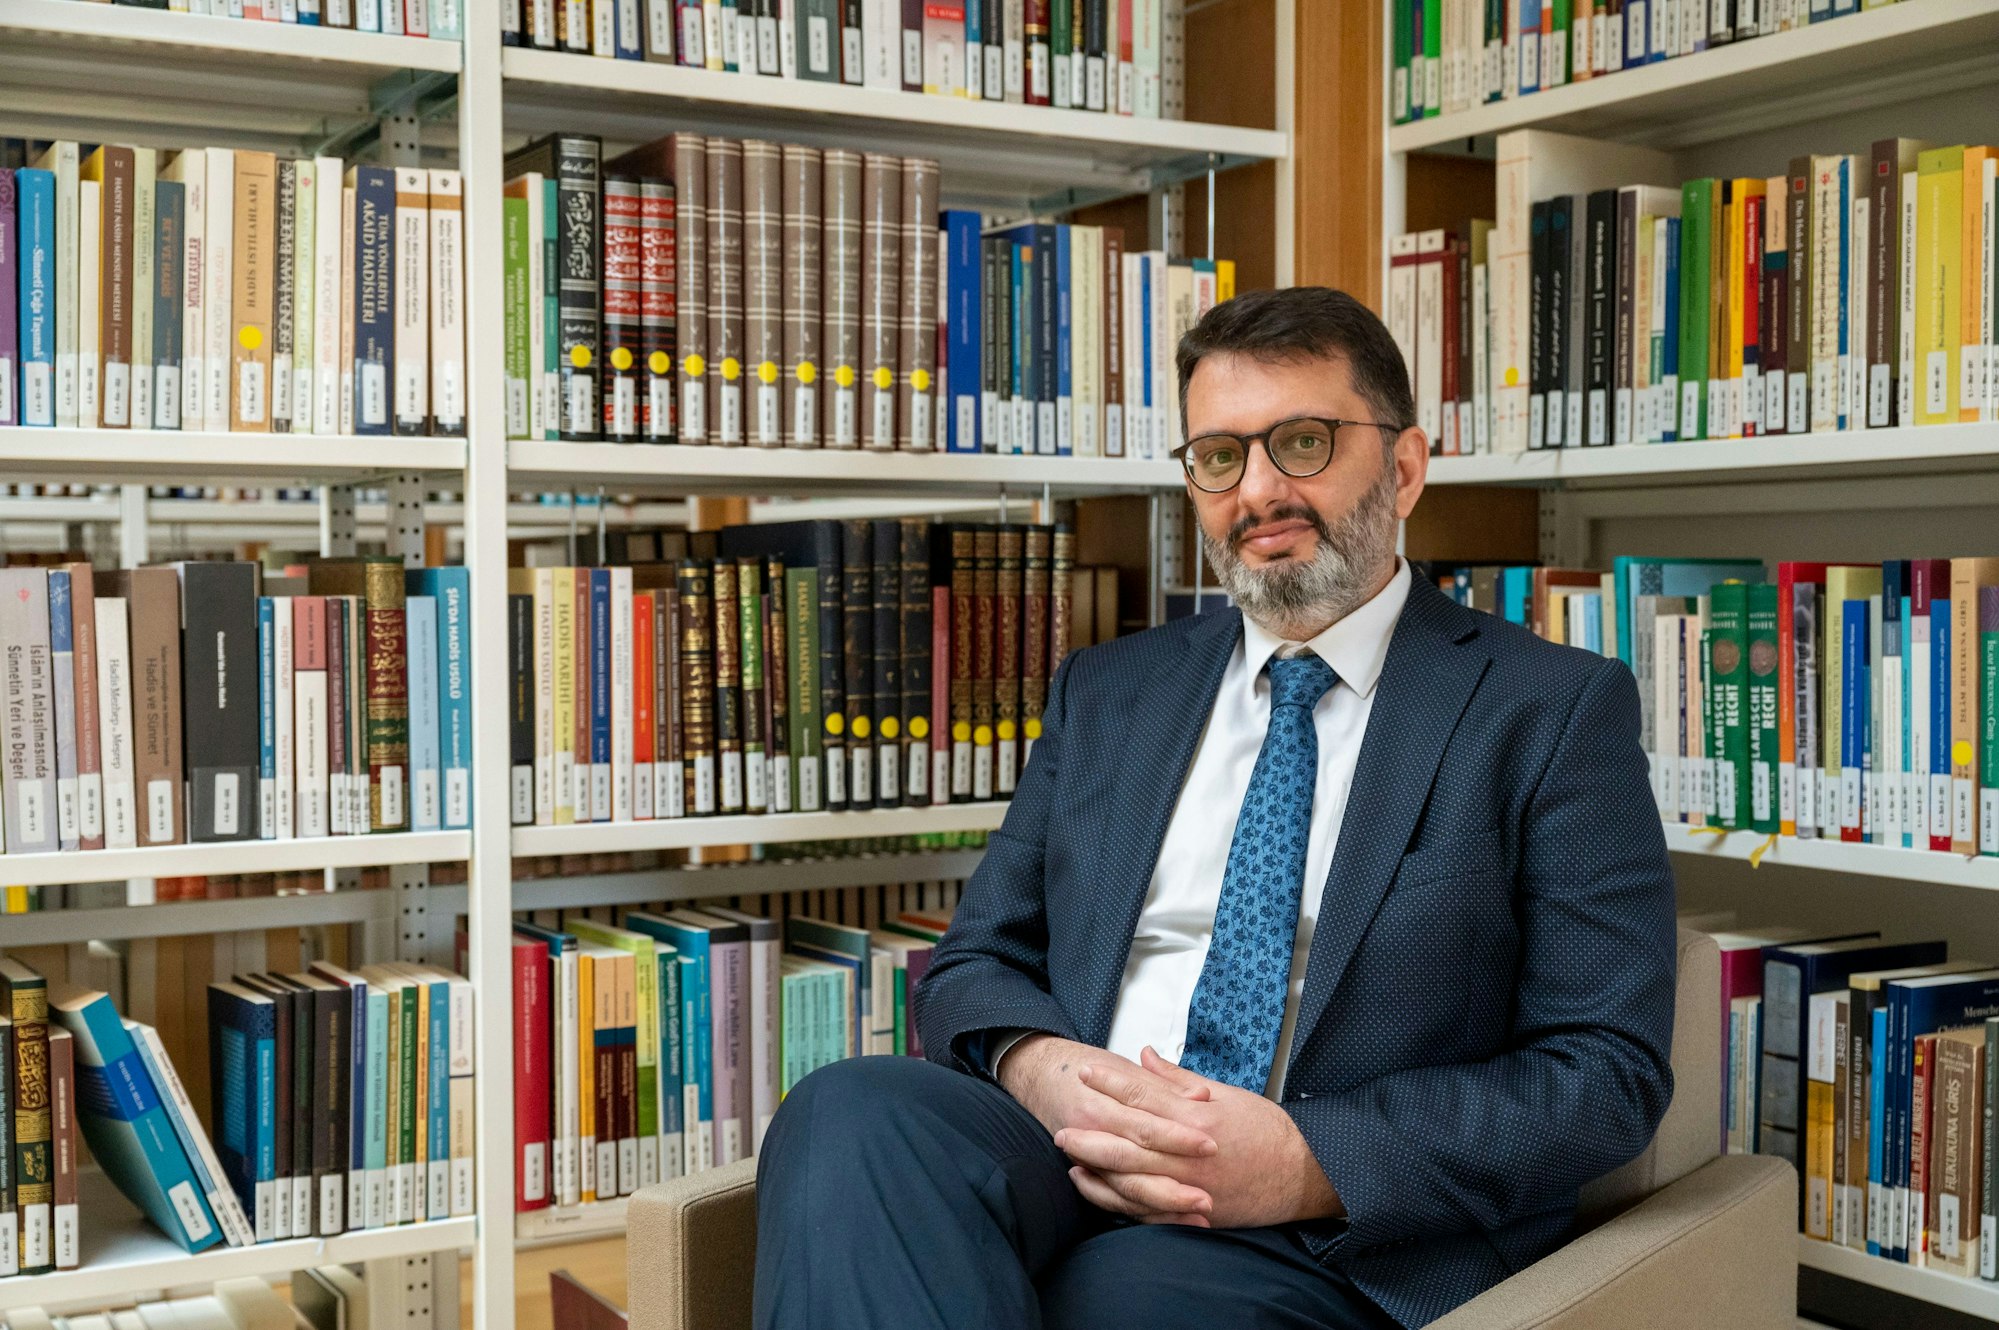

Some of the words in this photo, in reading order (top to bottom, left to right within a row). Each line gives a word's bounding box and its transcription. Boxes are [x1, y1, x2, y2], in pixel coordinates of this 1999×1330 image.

[362, 199, 375, 246] AKAİD
[377, 214, 388, 240] TÜM
[1794, 200, 1804, 218] Din
[1794, 220, 1804, 250] Hukuk
[32, 248, 44, 287] Sünneti
[362, 249, 376, 324] HADİSLERİ
[377, 244, 388, 313] YÖNLERİYLE
[30, 290, 44, 313] Çağa
[246, 269, 257, 307] HADİS
[31, 316, 44, 358] Taşımak
[445, 587, 458, 623] ŞİA'DA
[797, 581, 809, 623] HADİS
[1959, 600, 1967, 627] GİRİŞ
[448, 626, 459, 661] HADİS
[541, 605, 551, 648] HADİS
[559, 604, 572, 650] HADİS
[7, 646, 22, 696] Sünnetin
[30, 645, 46, 689] İslâm'ın
[109, 659, 121, 686] Hadis
[146, 658, 158, 693] Hadis
[797, 637, 811, 714] HADİSÇİLER
[1959, 632, 1967, 686] HUKUKUNA
[559, 655, 572, 704] TARİHİ
[10, 699, 24, 722] Yeri
[107, 686, 122, 726] Mezhep
[147, 696, 155, 710] ve
[1726, 684, 1739, 726] RECHT
[1762, 685, 1776, 729] RECHT
[1797, 694, 1807, 715] und
[1959, 691, 1967, 723] İSLÂM
[11, 726, 20, 739] ve
[29, 693, 49, 778] Anlaşılmasında
[147, 713, 159, 755] Sünnet
[1714, 684, 1724, 762] SLAMISCHE
[1751, 685, 1760, 762] LAMISCHE
[1797, 718, 1807, 748] Islam
[11, 743, 26, 779] Değeri
[108, 734, 123, 769] Meşrep
[665, 960, 677, 1005] Speaking
[728, 949, 739, 995] Islamic
[668, 1007, 677, 1016] in
[729, 999, 740, 1039] Public
[669, 1019, 679, 1045] God's
[670, 1048, 680, 1075] Name
[730, 1043, 739, 1068] Law
[1945, 1078, 1960, 1113] GİRİŞ
[1944, 1117, 1959, 1190] HUKUKUNA
